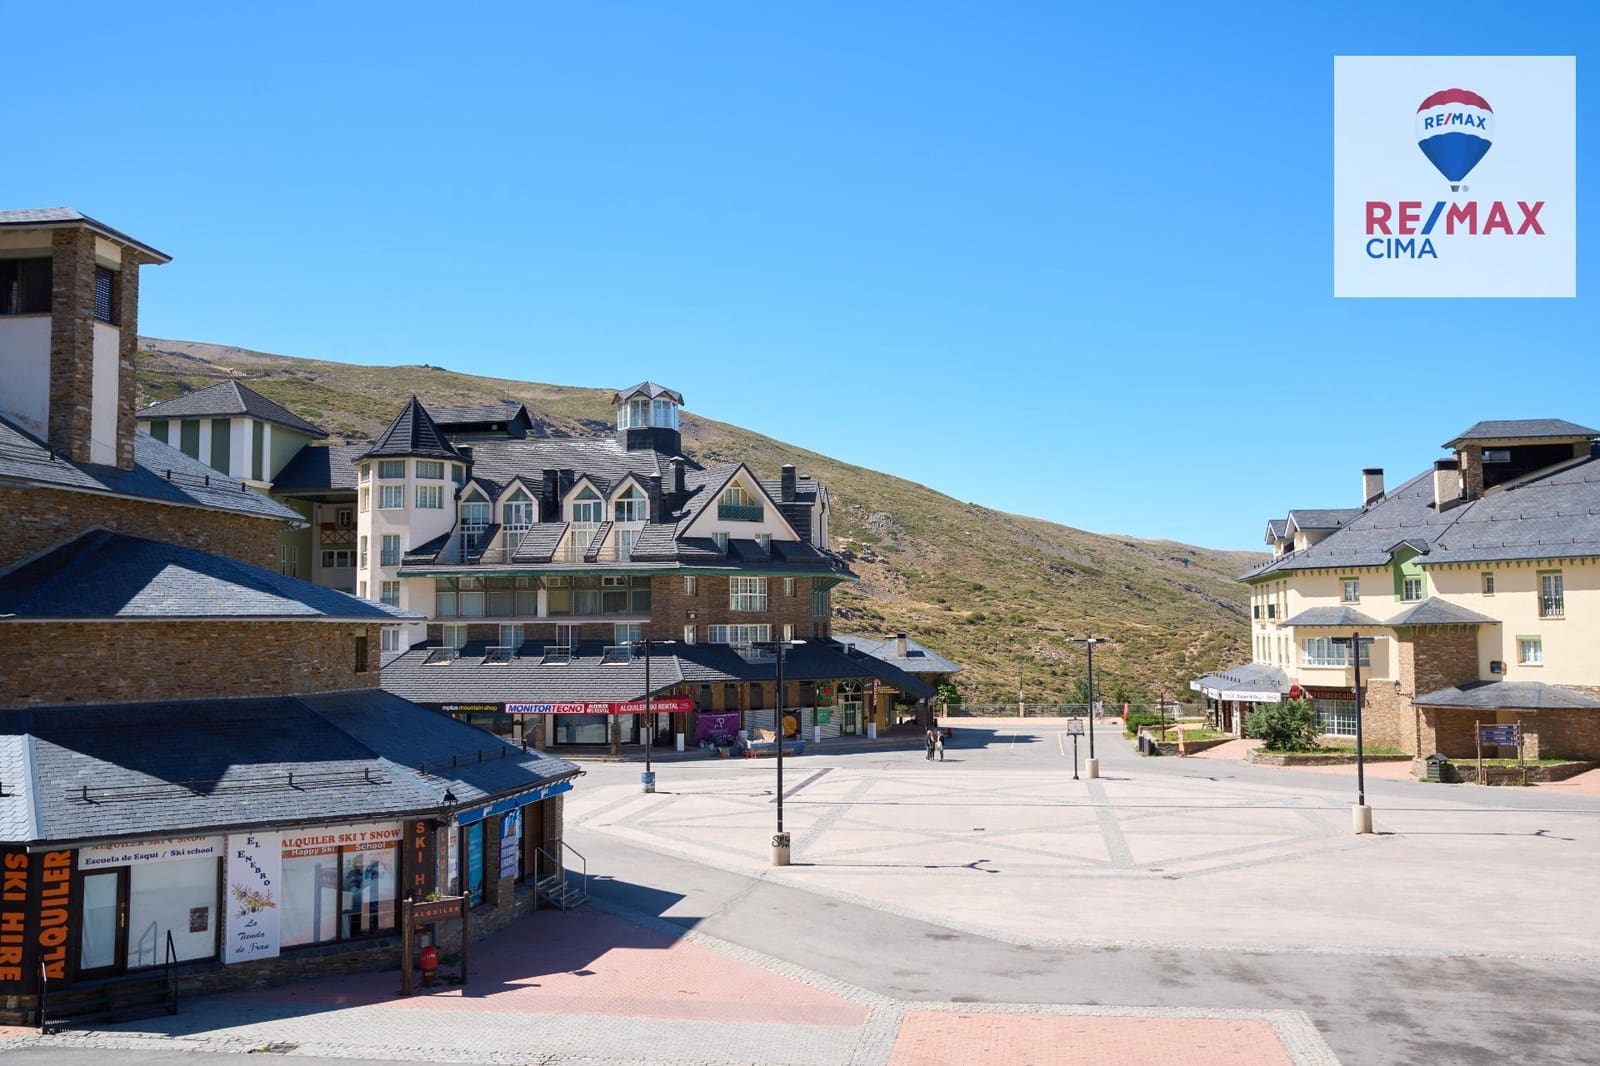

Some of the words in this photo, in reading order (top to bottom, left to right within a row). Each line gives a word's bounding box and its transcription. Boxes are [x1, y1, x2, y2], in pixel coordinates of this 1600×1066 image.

[508, 704, 583, 712] MONITORTECNO
[246, 837, 261, 848] EL
[281, 834, 336, 849] ALQUILER
[338, 832, 357, 843] SKI
[360, 832, 367, 841] Y
[369, 829, 401, 840] SNOW
[415, 821, 426, 863] SKI
[85, 856, 120, 865] Escuela
[121, 854, 133, 862] de
[134, 852, 159, 861] Esqui
[170, 848, 185, 857] Ski
[186, 846, 214, 855] school
[291, 847, 320, 857] Happy
[321, 846, 336, 855] Ski
[355, 841, 387, 851] School
[3, 852, 29, 901] SKI
[38, 850, 72, 979] ALQUILER
[413, 906, 461, 918] ALQUILER
[245, 919, 258, 928] La
[237, 931, 265, 941] Tienda
[0, 912, 25, 981] HIRE
[235, 944, 246, 954] de
[247, 942, 270, 954] Fran
